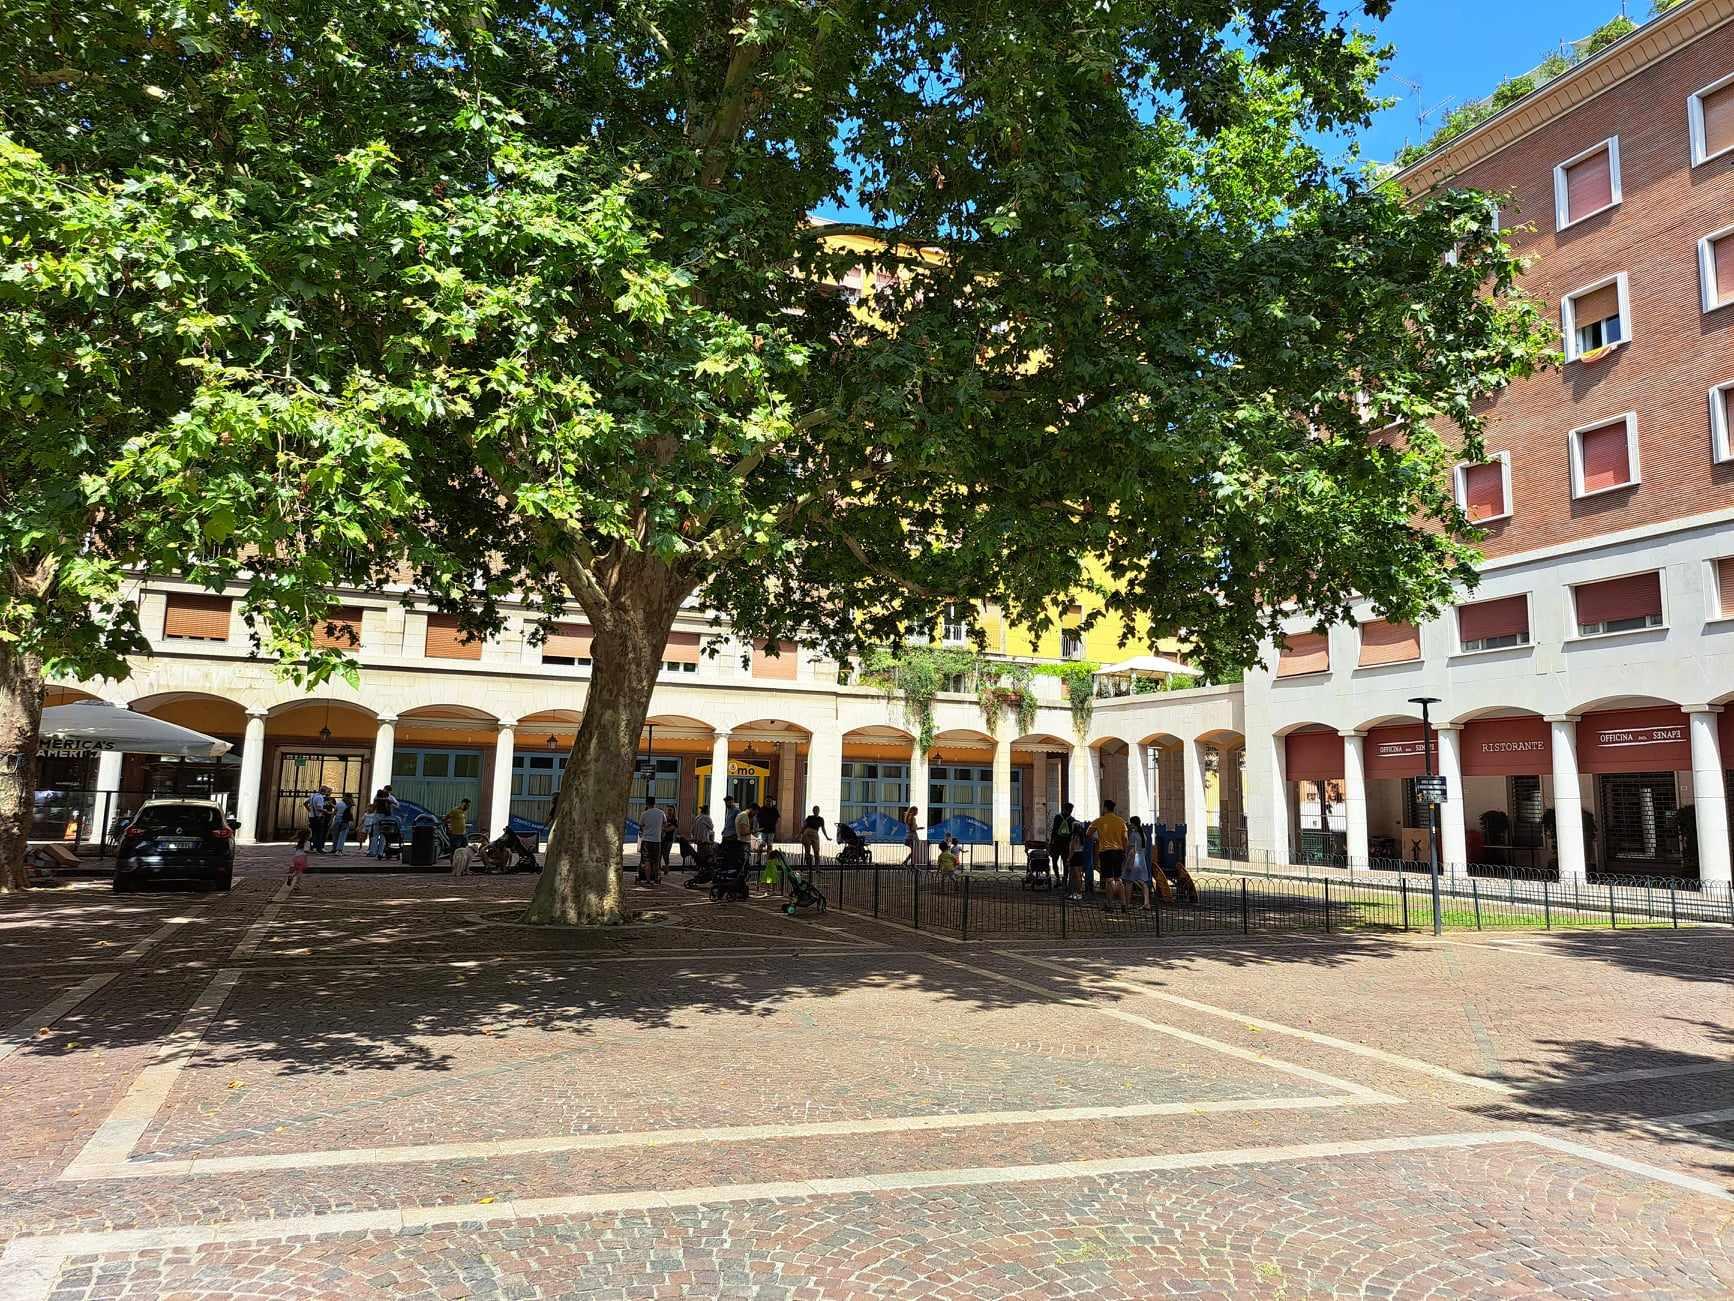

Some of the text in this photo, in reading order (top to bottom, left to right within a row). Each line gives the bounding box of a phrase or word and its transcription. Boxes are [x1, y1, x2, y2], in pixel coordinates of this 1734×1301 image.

[1600, 733, 1633, 743] OFFICINA
[39, 738, 115, 750] MERICA'S
[1482, 741, 1545, 752] RISTORANTE
